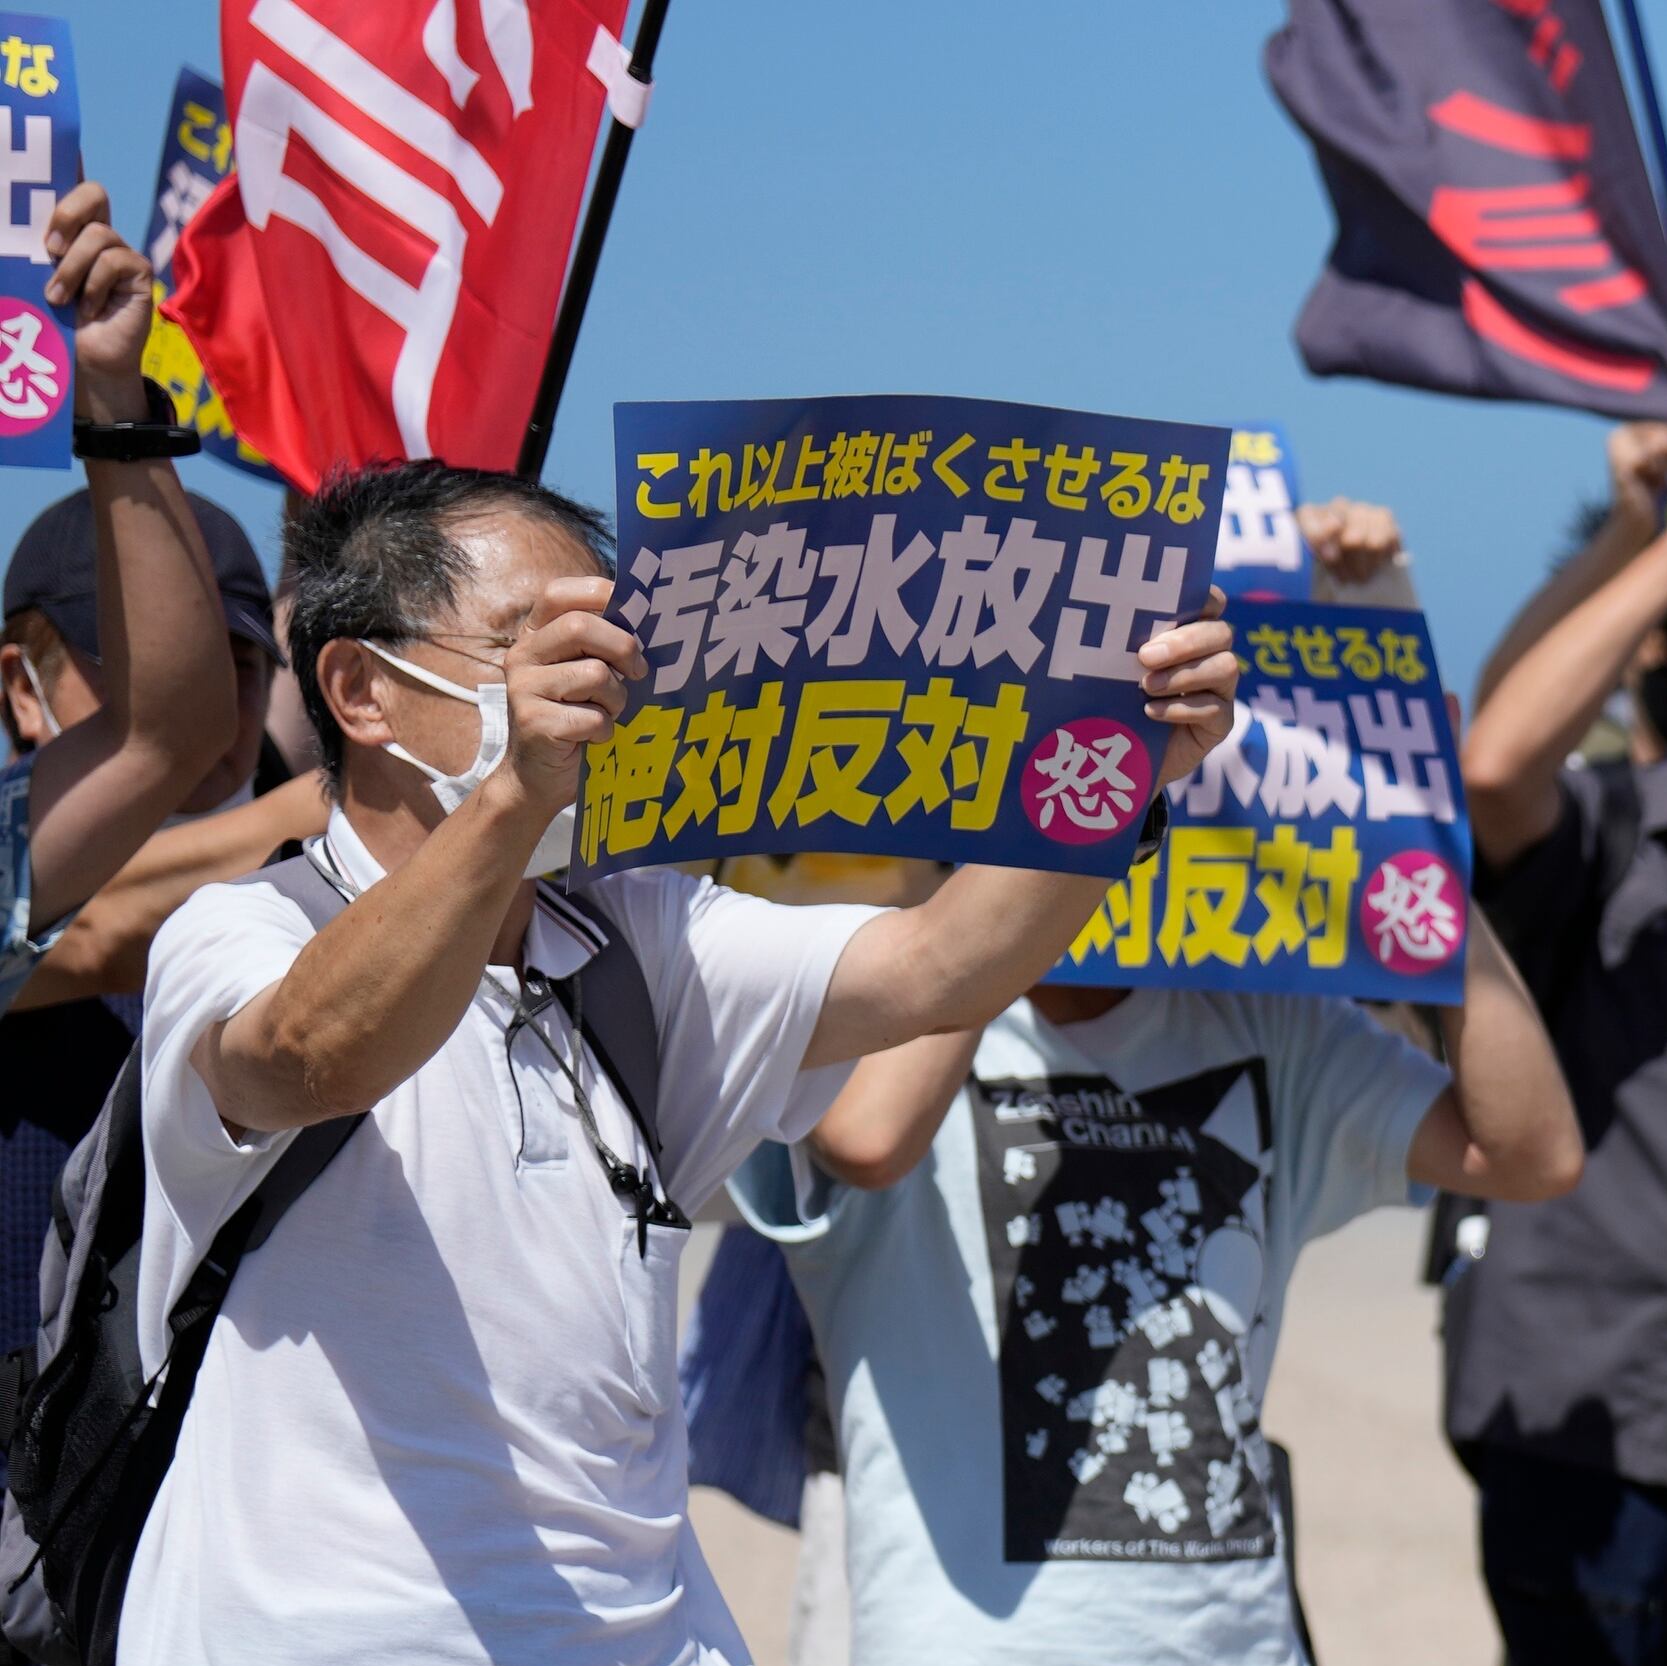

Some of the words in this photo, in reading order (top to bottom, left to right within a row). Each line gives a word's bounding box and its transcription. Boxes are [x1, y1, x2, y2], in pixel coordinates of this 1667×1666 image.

[0, 36, 60, 98] な
[635, 430, 1208, 524] これ以上被ばくさせるな
[620, 514, 1190, 694] 汚染水放出
[1237, 623, 1429, 683] させるな
[580, 678, 1030, 867] 絶対反対
[1034, 727, 1138, 831] 怒
[1368, 862, 1459, 961] 怒
